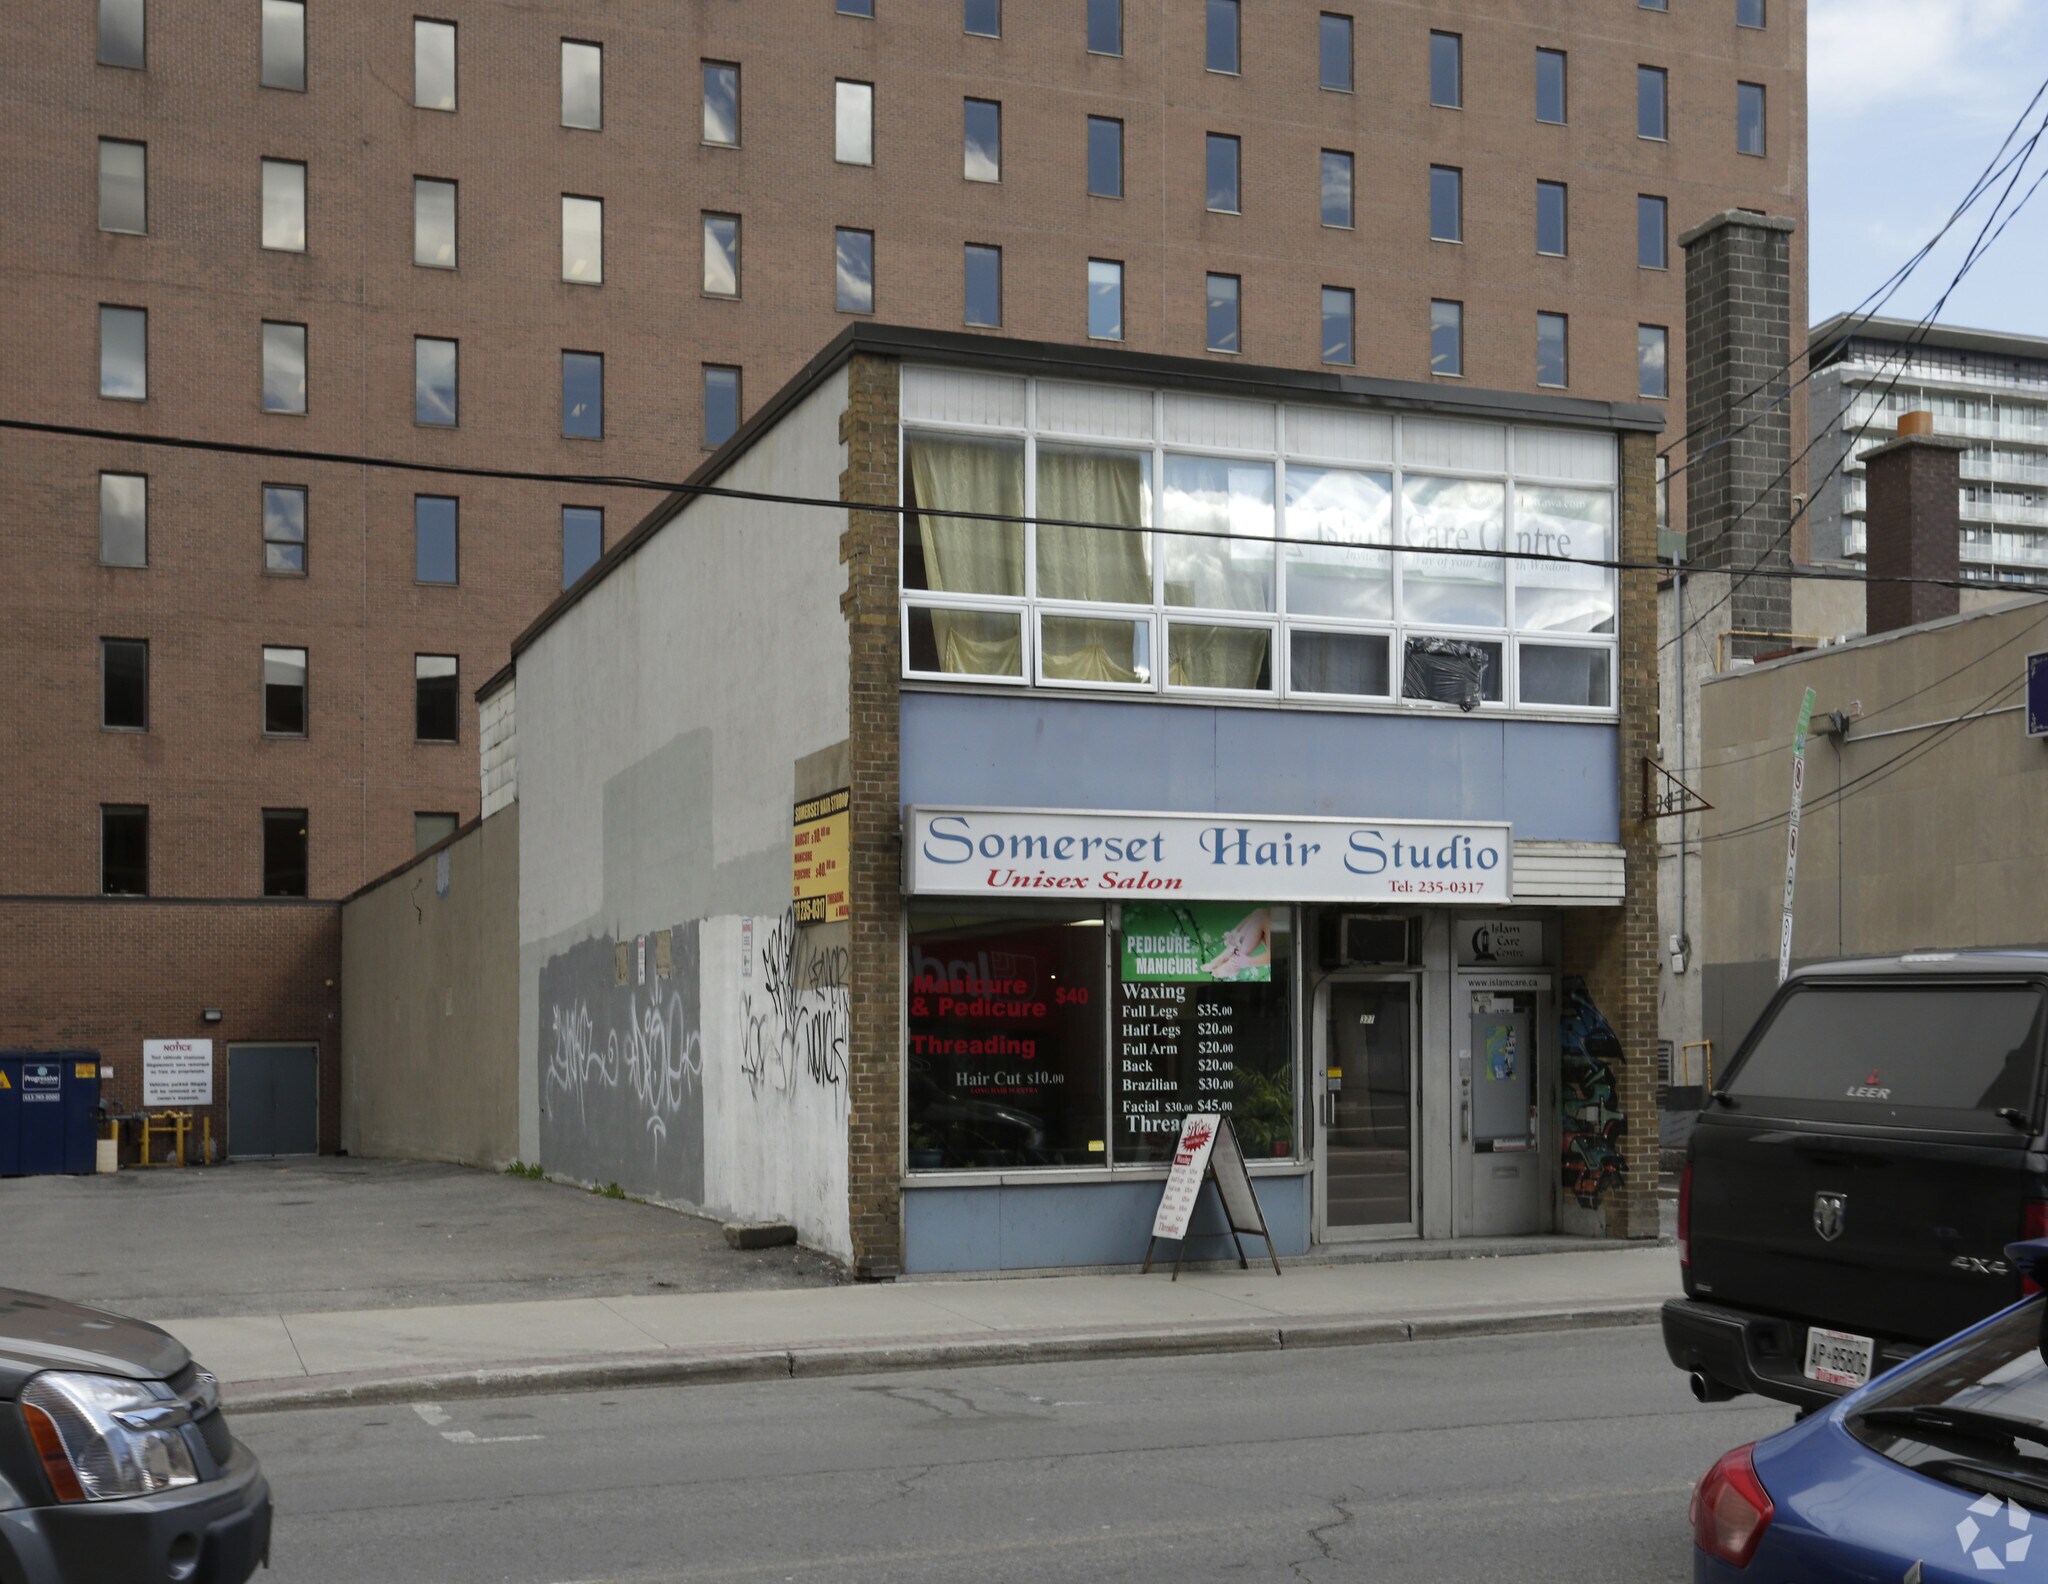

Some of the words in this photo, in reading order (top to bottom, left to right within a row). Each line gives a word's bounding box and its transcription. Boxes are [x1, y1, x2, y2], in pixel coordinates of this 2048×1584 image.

[795, 800, 820, 823] SOMERSET
[922, 816, 1166, 865] Somerset
[1198, 826, 1322, 868] Hair
[1344, 830, 1499, 875] Studio
[987, 868, 1089, 891] Unisex
[1098, 869, 1184, 892] Salon
[1388, 879, 1414, 894] Tel:
[1418, 880, 1485, 895] 235-0317
[1491, 922, 1521, 934] Islam
[1127, 935, 1191, 955] PEDICURE
[1136, 956, 1199, 976] MANICURE
[914, 975, 1028, 995] Manicure
[1468, 979, 1538, 987] www.islamcare.ca
[1056, 987, 1089, 1006] $40
[1121, 983, 1186, 1003] Waxing
[911, 997, 929, 1017] &
[938, 997, 1047, 1017] Pedicure
[1122, 1005, 1147, 1018] Full
[1150, 1005, 1179, 1020] Legs
[1197, 1003, 1233, 1018] $35.00
[1122, 1023, 1152, 1037] Half
[1153, 1024, 1181, 1039] Legs
[1197, 1022, 1233, 1037] $20.00
[163, 1044, 192, 1052] NOTICE
[911, 1035, 1036, 1059] Threading
[1122, 1043, 1147, 1056] Full
[1149, 1043, 1178, 1056] Arm
[1198, 1041, 1234, 1056] $20.00
[1122, 1059, 1154, 1073] Back
[1198, 1057, 1234, 1073] $20.00
[956, 1072, 990, 1087] Hair
[994, 1071, 1021, 1086] Cut
[1027, 1071, 1065, 1085] $10.00
[1122, 1077, 1178, 1092] Brazilian
[1198, 1077, 1234, 1092] $30.00
[1846, 1086, 1892, 1100] LEER
[1122, 1099, 1160, 1114] Facial
[1164, 1101, 1193, 1114] $30.00
[1197, 1099, 1233, 1114] $45.00
